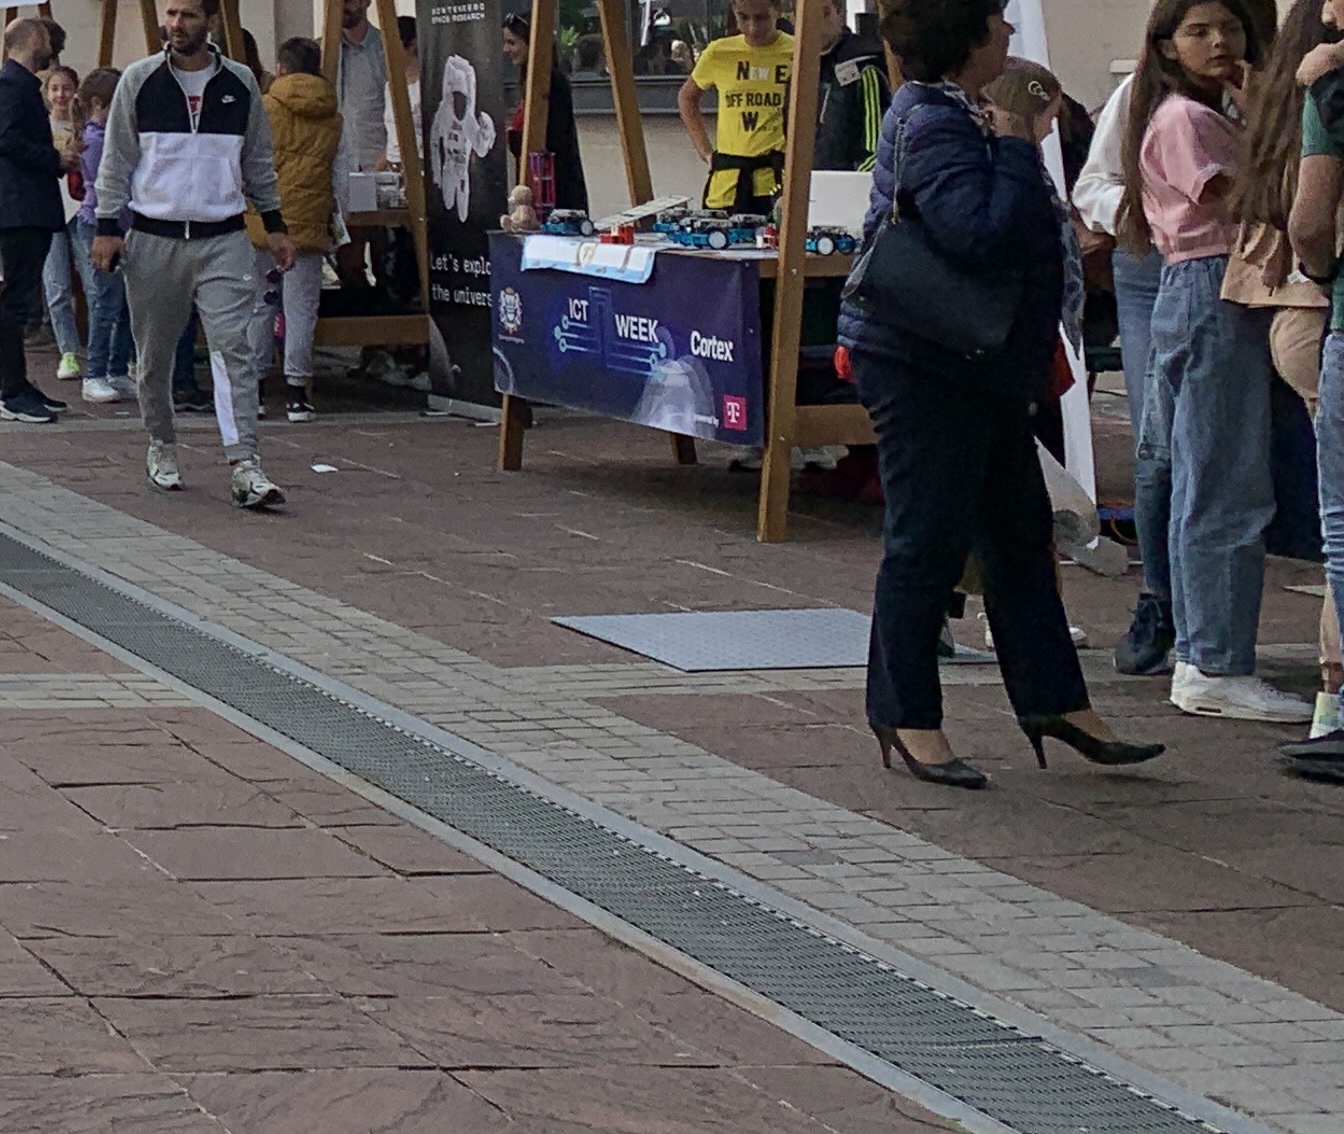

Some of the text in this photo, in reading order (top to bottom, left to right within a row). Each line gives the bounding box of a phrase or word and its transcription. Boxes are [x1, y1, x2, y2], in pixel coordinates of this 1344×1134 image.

[452, 13, 485, 22] RESEARCH
[746, 92, 782, 107] ROAD
[430, 253, 460, 273] Let's
[432, 283, 451, 302] the
[568, 297, 589, 321] ICT
[615, 314, 659, 343] WEEK
[690, 330, 734, 362] Cortex
